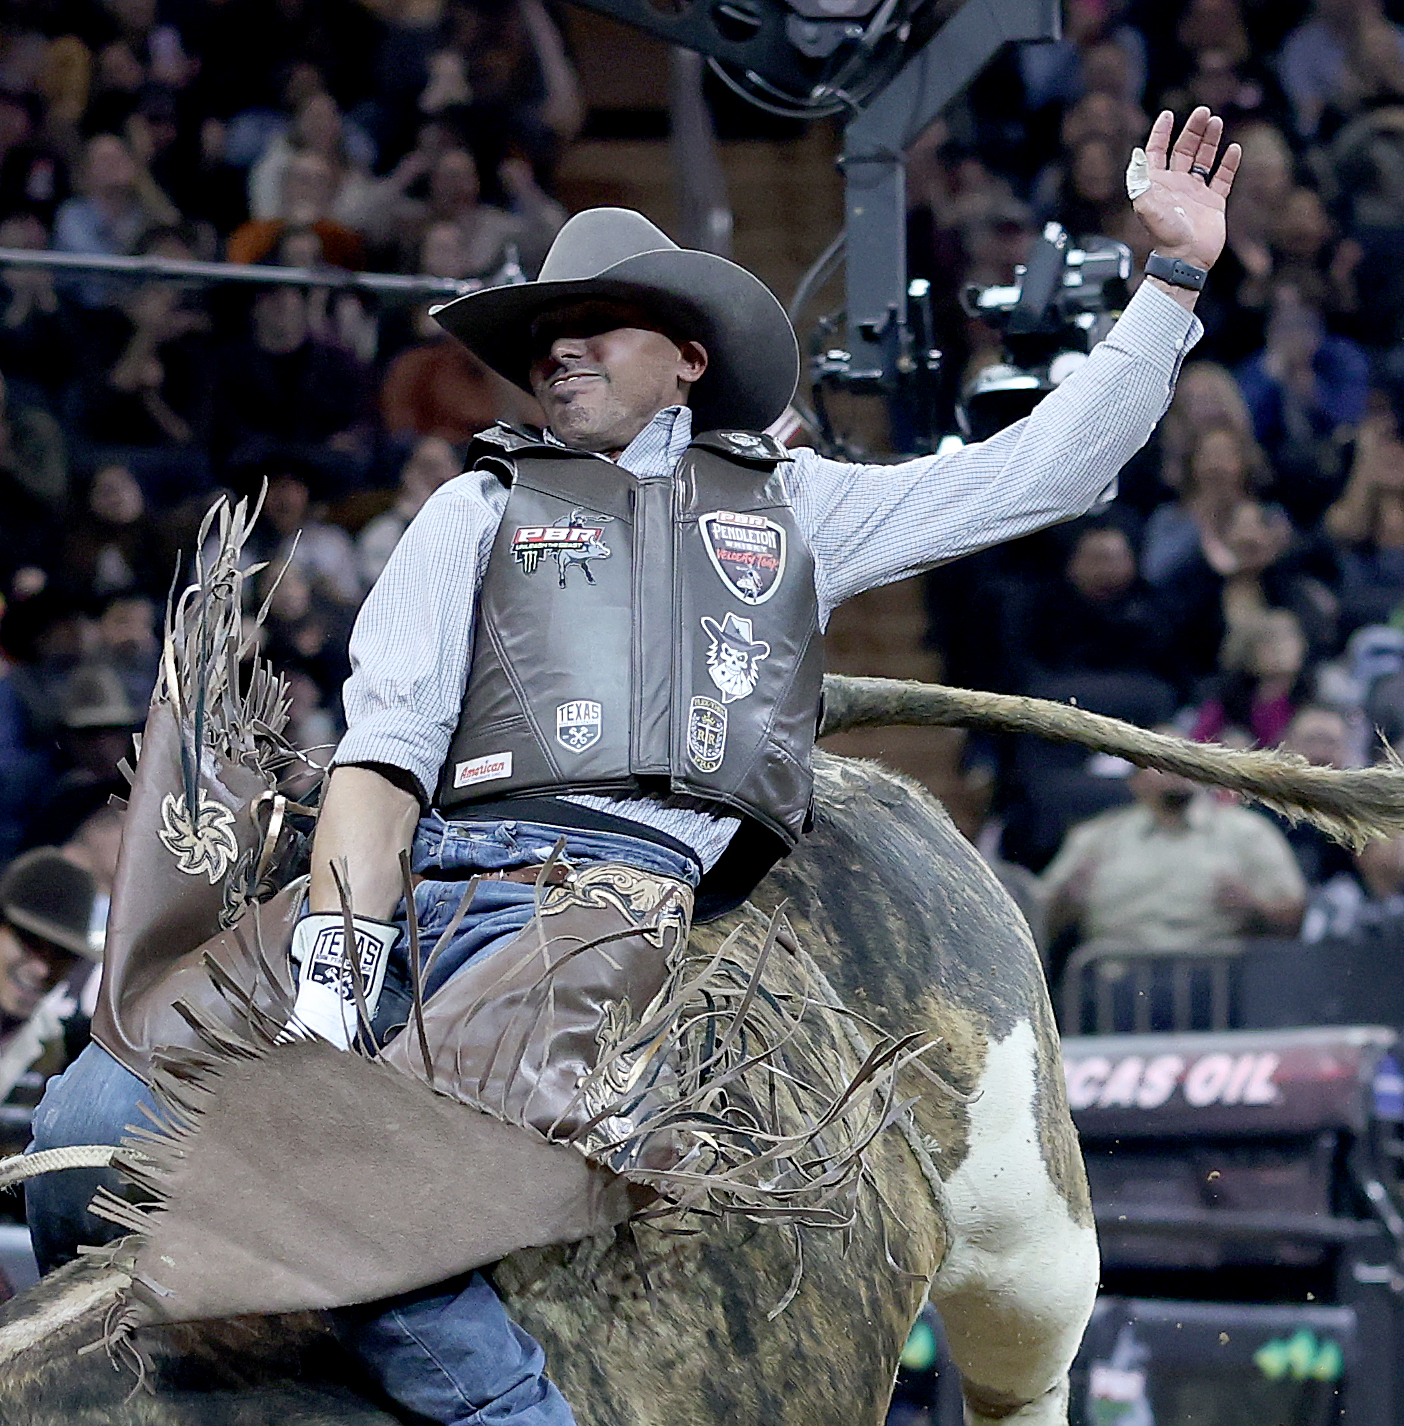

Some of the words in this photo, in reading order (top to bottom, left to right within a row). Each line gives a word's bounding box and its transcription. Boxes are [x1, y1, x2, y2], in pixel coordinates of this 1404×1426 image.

[719, 512, 765, 526] PBR
[518, 528, 596, 542] PBR
[712, 522, 777, 549] PENDLETON
[725, 540, 768, 553] WHISKY
[559, 703, 599, 721] TEXAS
[460, 759, 505, 780] American
[320, 931, 378, 966] TEAS
[1064, 1053, 1185, 1110] CAS
[1184, 1052, 1280, 1108] OIL
